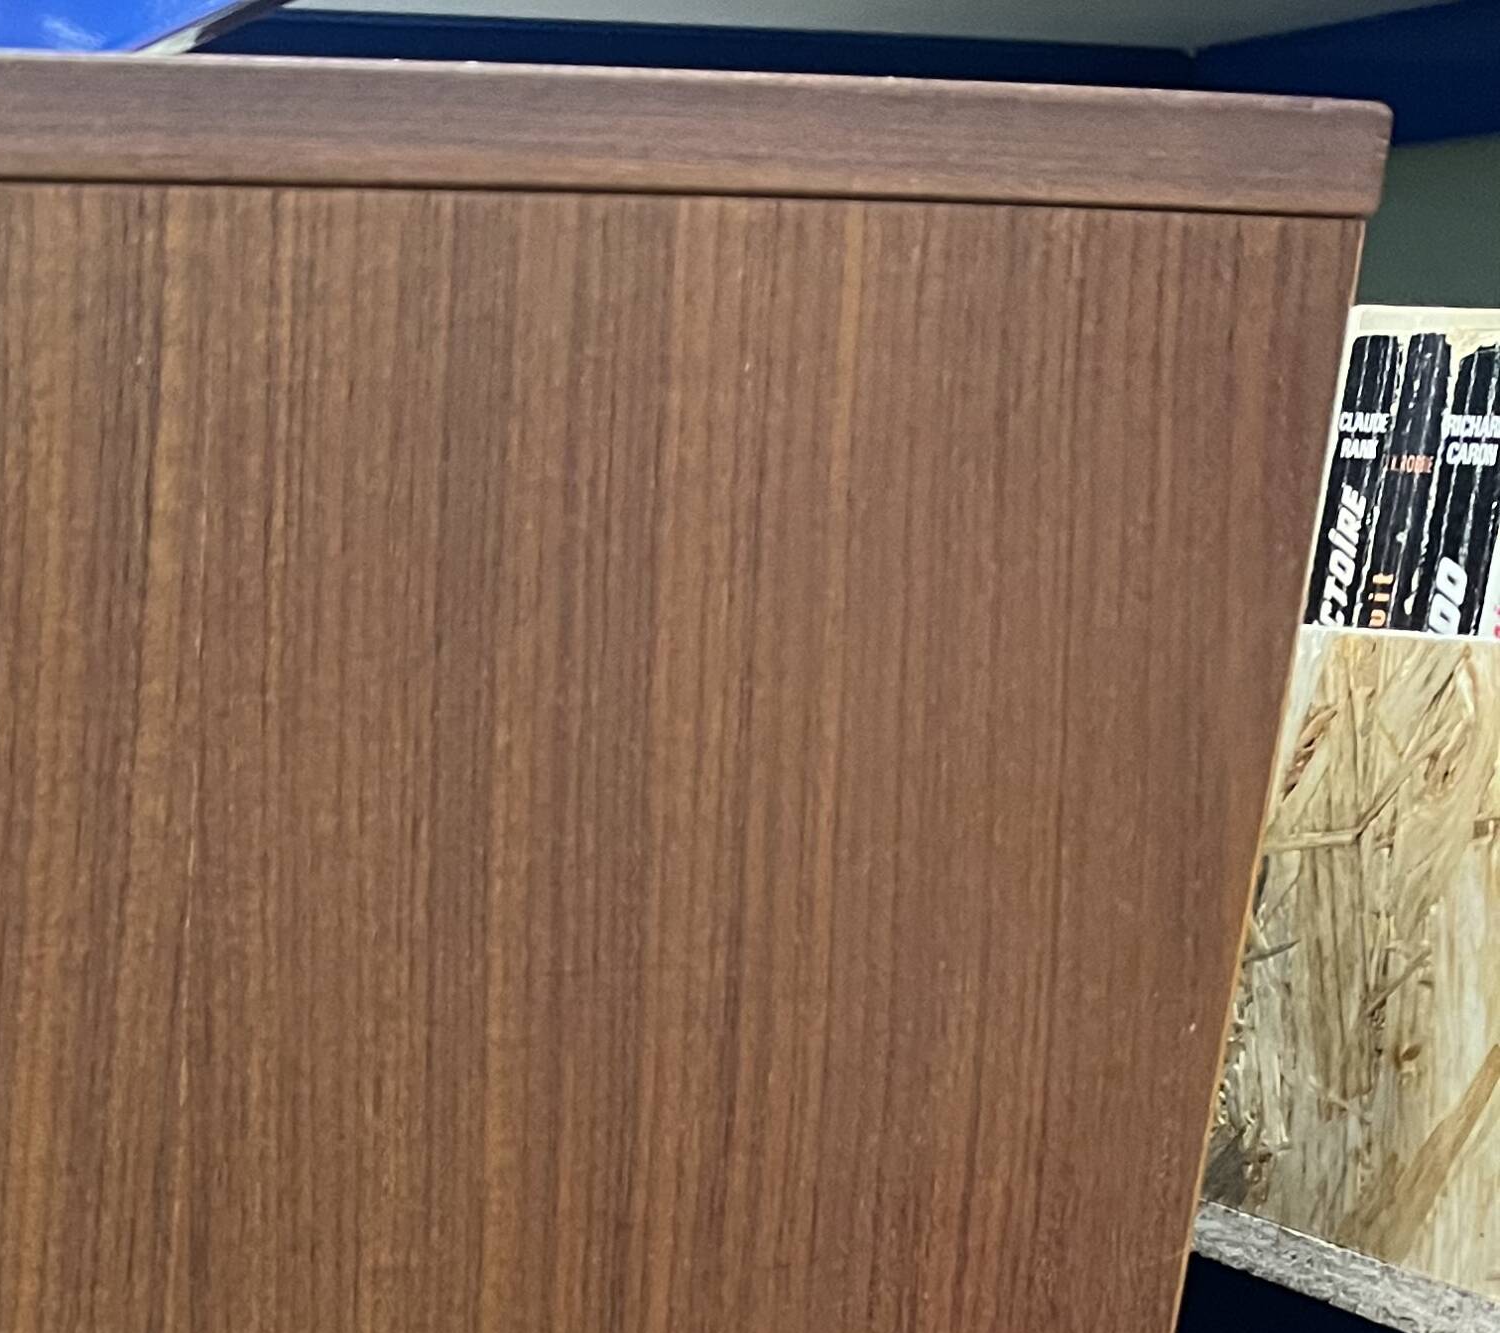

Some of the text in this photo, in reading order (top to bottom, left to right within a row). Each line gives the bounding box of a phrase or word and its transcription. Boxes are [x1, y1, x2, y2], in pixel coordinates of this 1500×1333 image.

[1339, 412, 1390, 433] CLAUDE
[1444, 412, 1500, 438] RICHAR
[1340, 438, 1378, 459] RANK
[1312, 483, 1367, 627] CTOIRE
